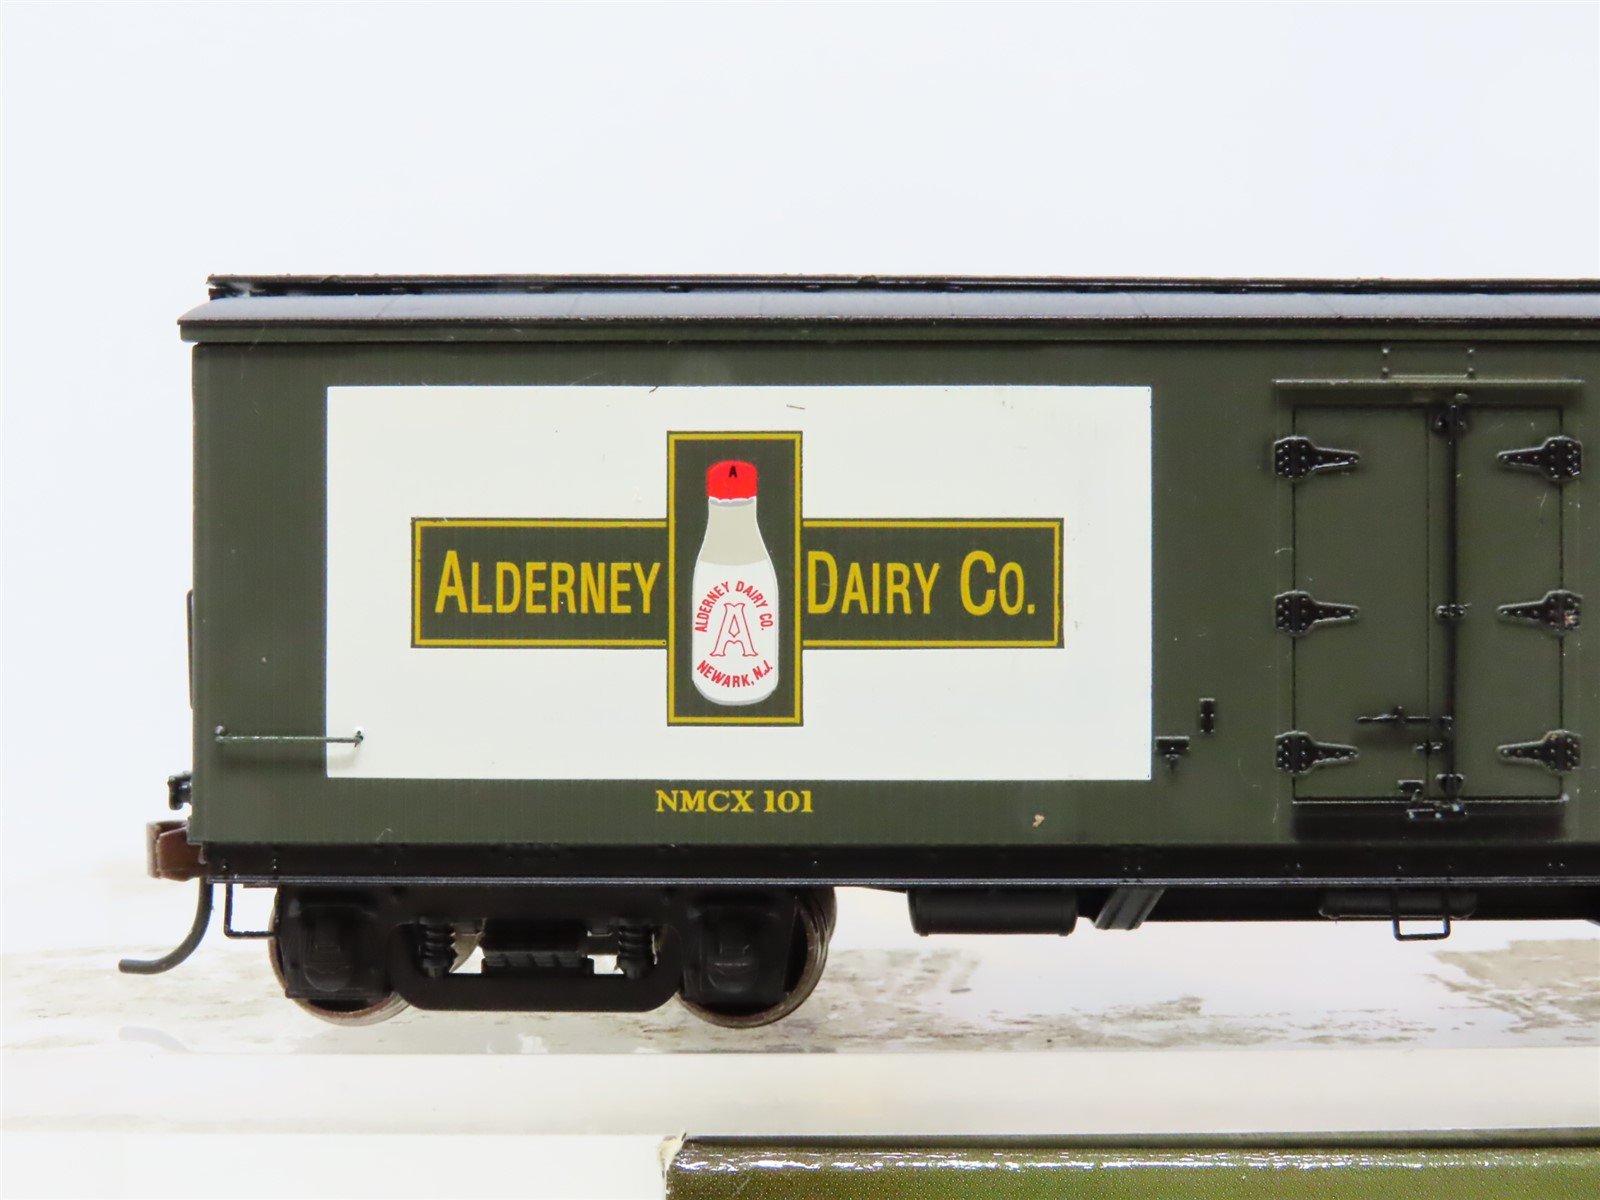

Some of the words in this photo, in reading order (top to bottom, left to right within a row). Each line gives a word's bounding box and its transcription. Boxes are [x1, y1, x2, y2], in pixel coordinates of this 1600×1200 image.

[728, 465, 738, 478] A
[694, 581, 731, 632] ALDERNEY
[735, 580, 769, 608] DAIRY
[759, 613, 774, 631] CO.
[710, 602, 758, 657] A
[696, 659, 755, 688] NEWARK,
[654, 788, 754, 814] NMCX
[763, 788, 814, 814] 101
